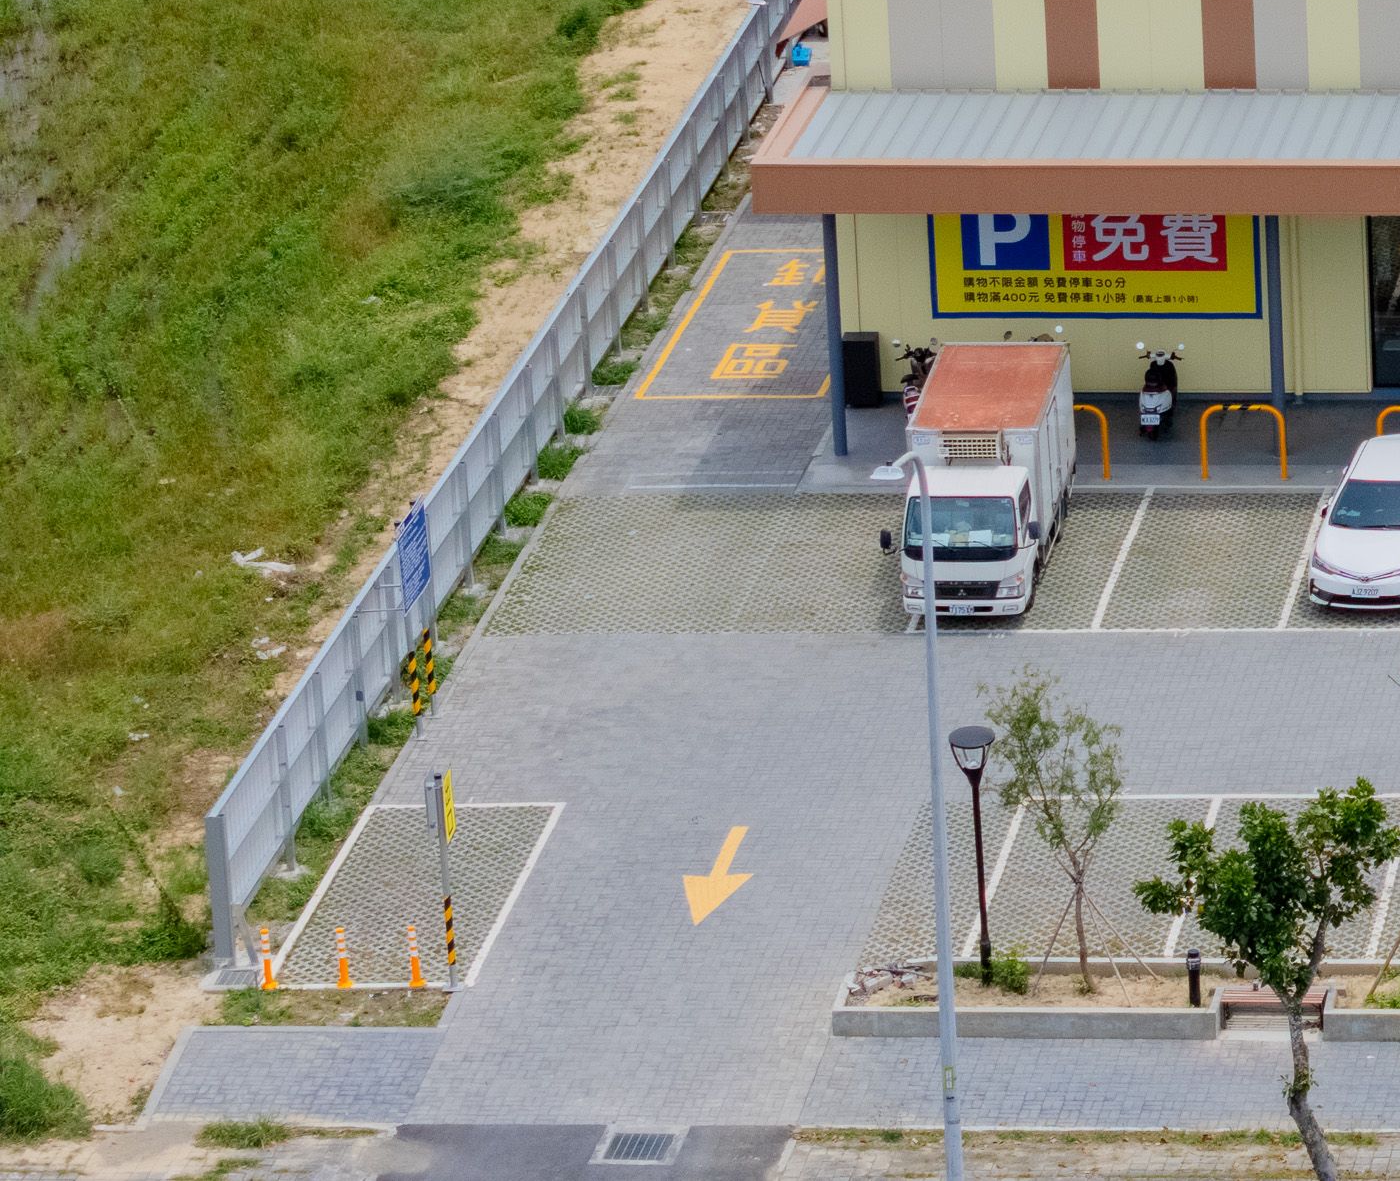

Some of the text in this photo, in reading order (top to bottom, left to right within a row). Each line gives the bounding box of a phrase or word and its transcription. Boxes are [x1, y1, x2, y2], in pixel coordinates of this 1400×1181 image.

[977, 214, 1032, 266] P
[1090, 214, 1219, 263] 免費
[963, 276, 1126, 288] 購物不限金額 免費停車30分
[964, 292, 1040, 303] 購物滿400元
[1044, 292, 1126, 304] 免費停車1小時
